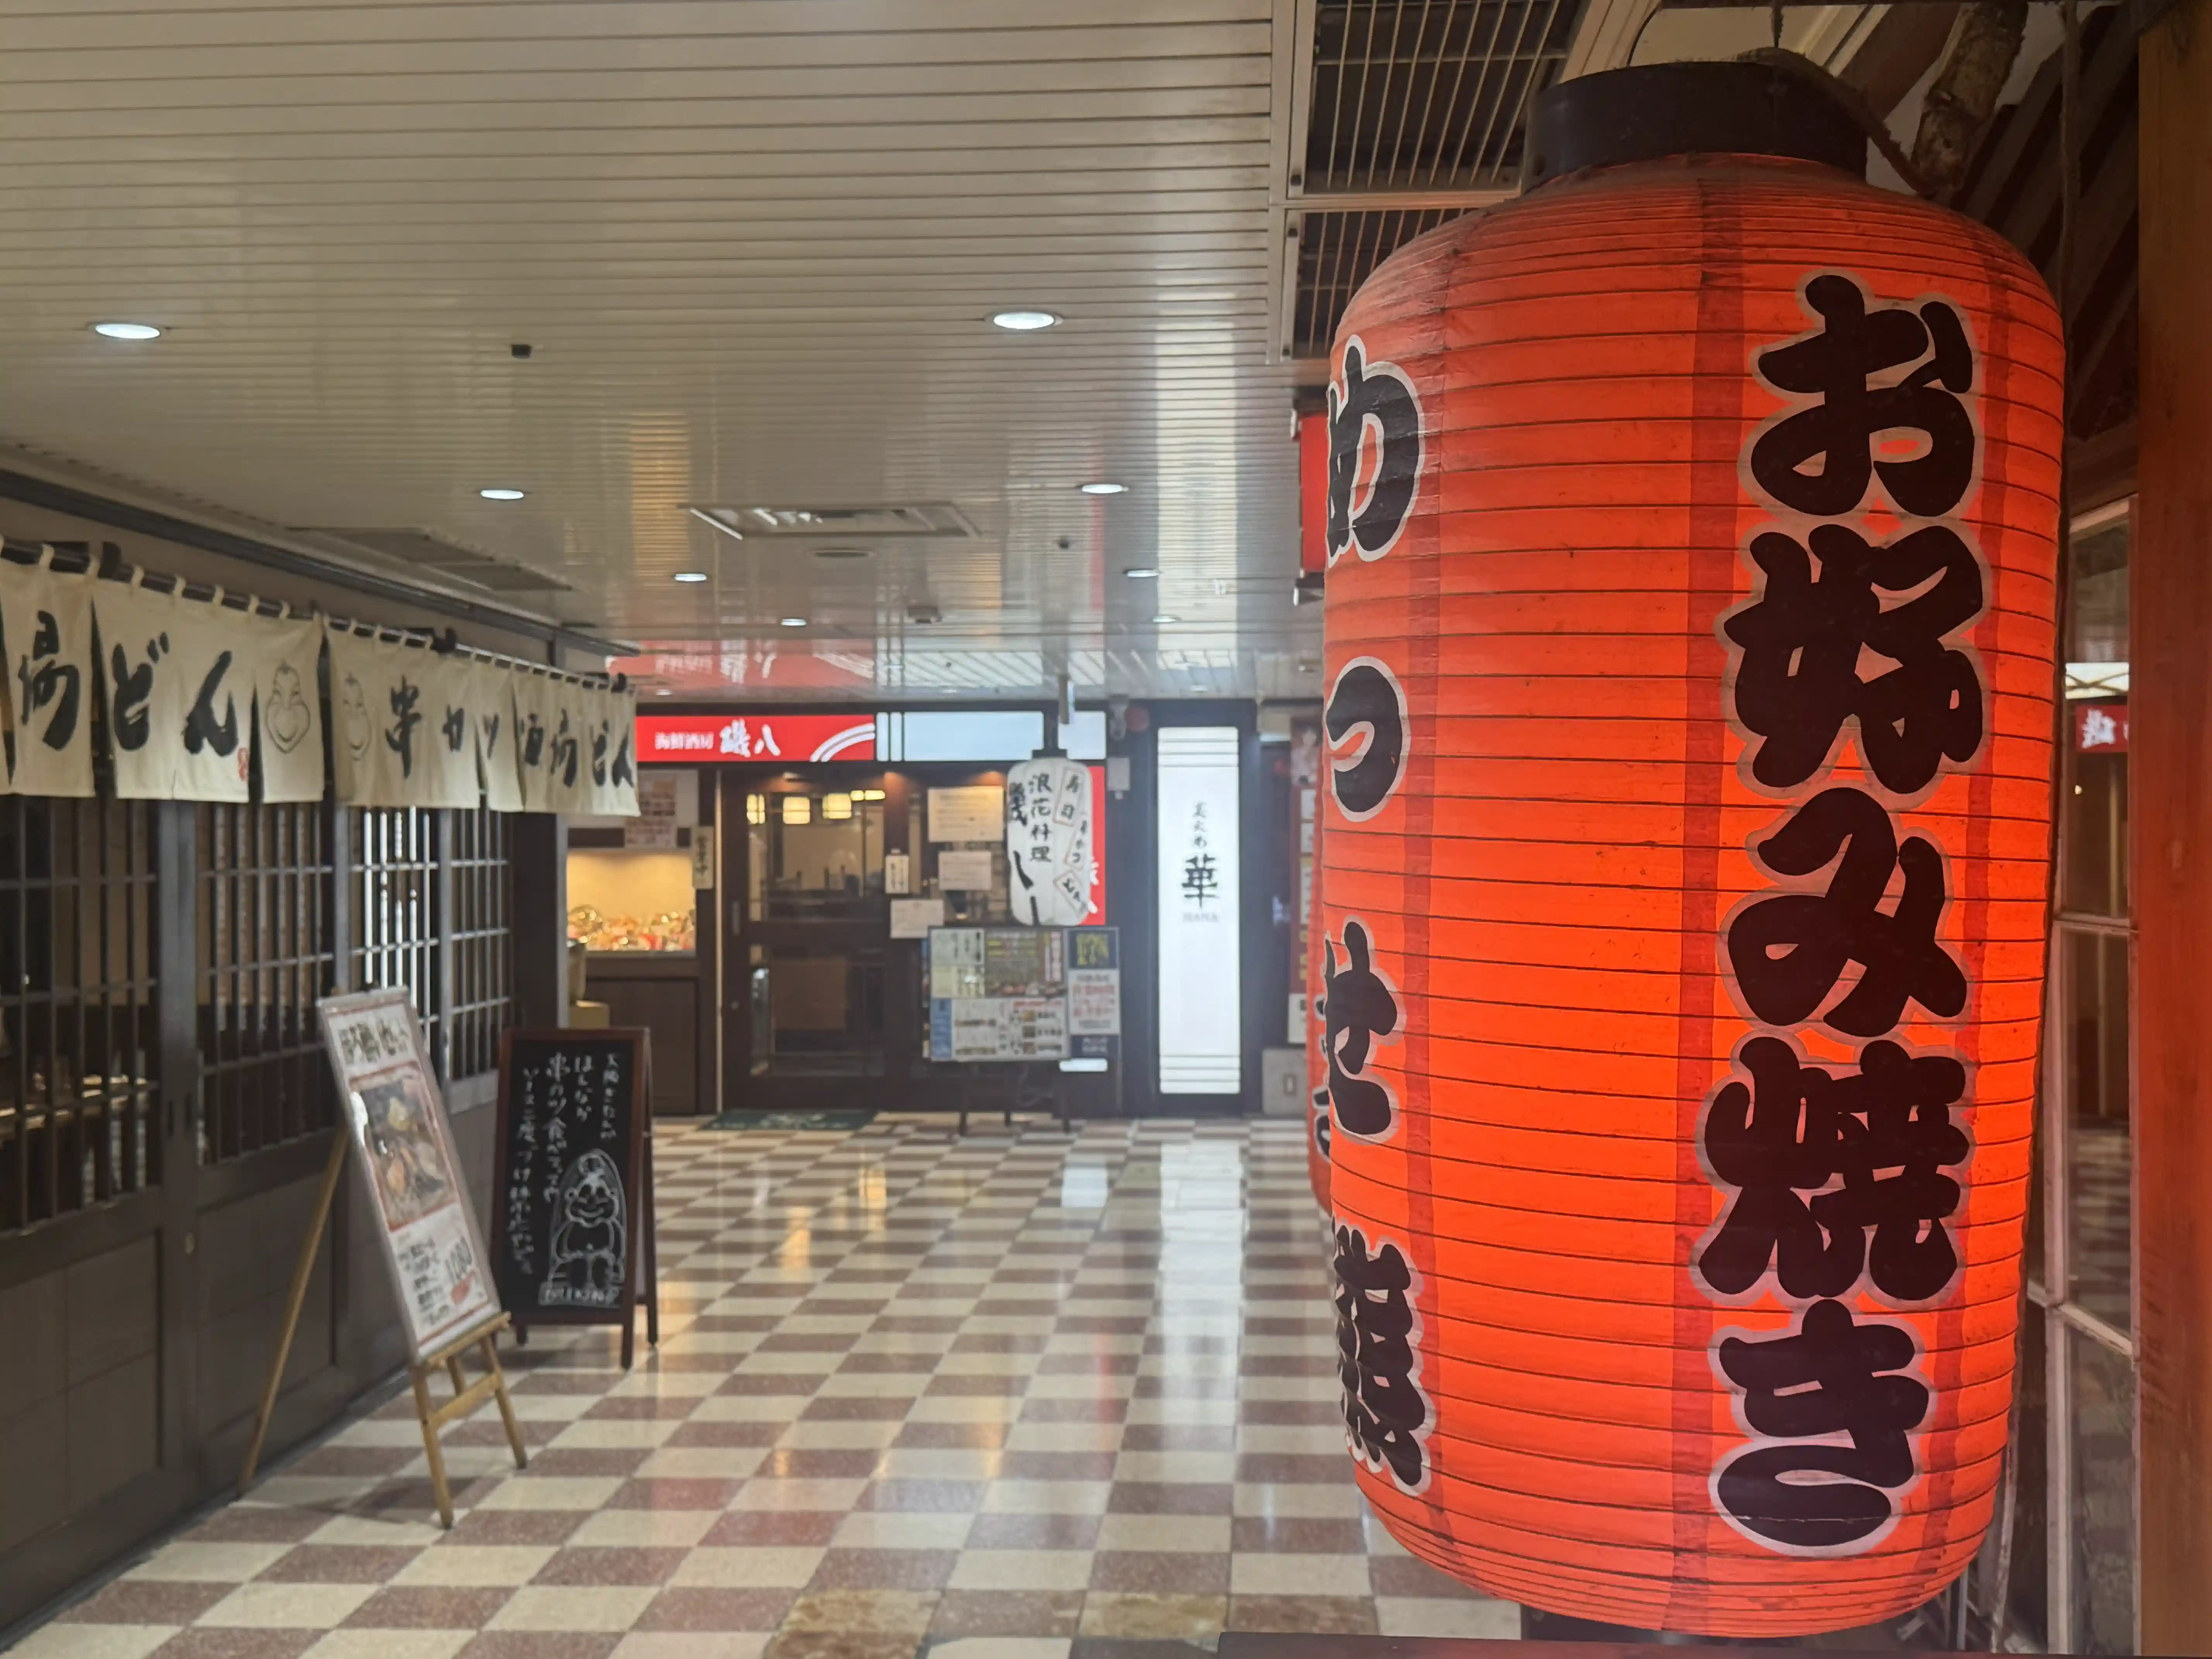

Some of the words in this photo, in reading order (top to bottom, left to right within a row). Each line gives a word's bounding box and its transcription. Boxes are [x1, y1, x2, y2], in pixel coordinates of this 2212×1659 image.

[1181, 853, 1219, 908] 華
[1699, 276, 1984, 1545] お好み焼き
